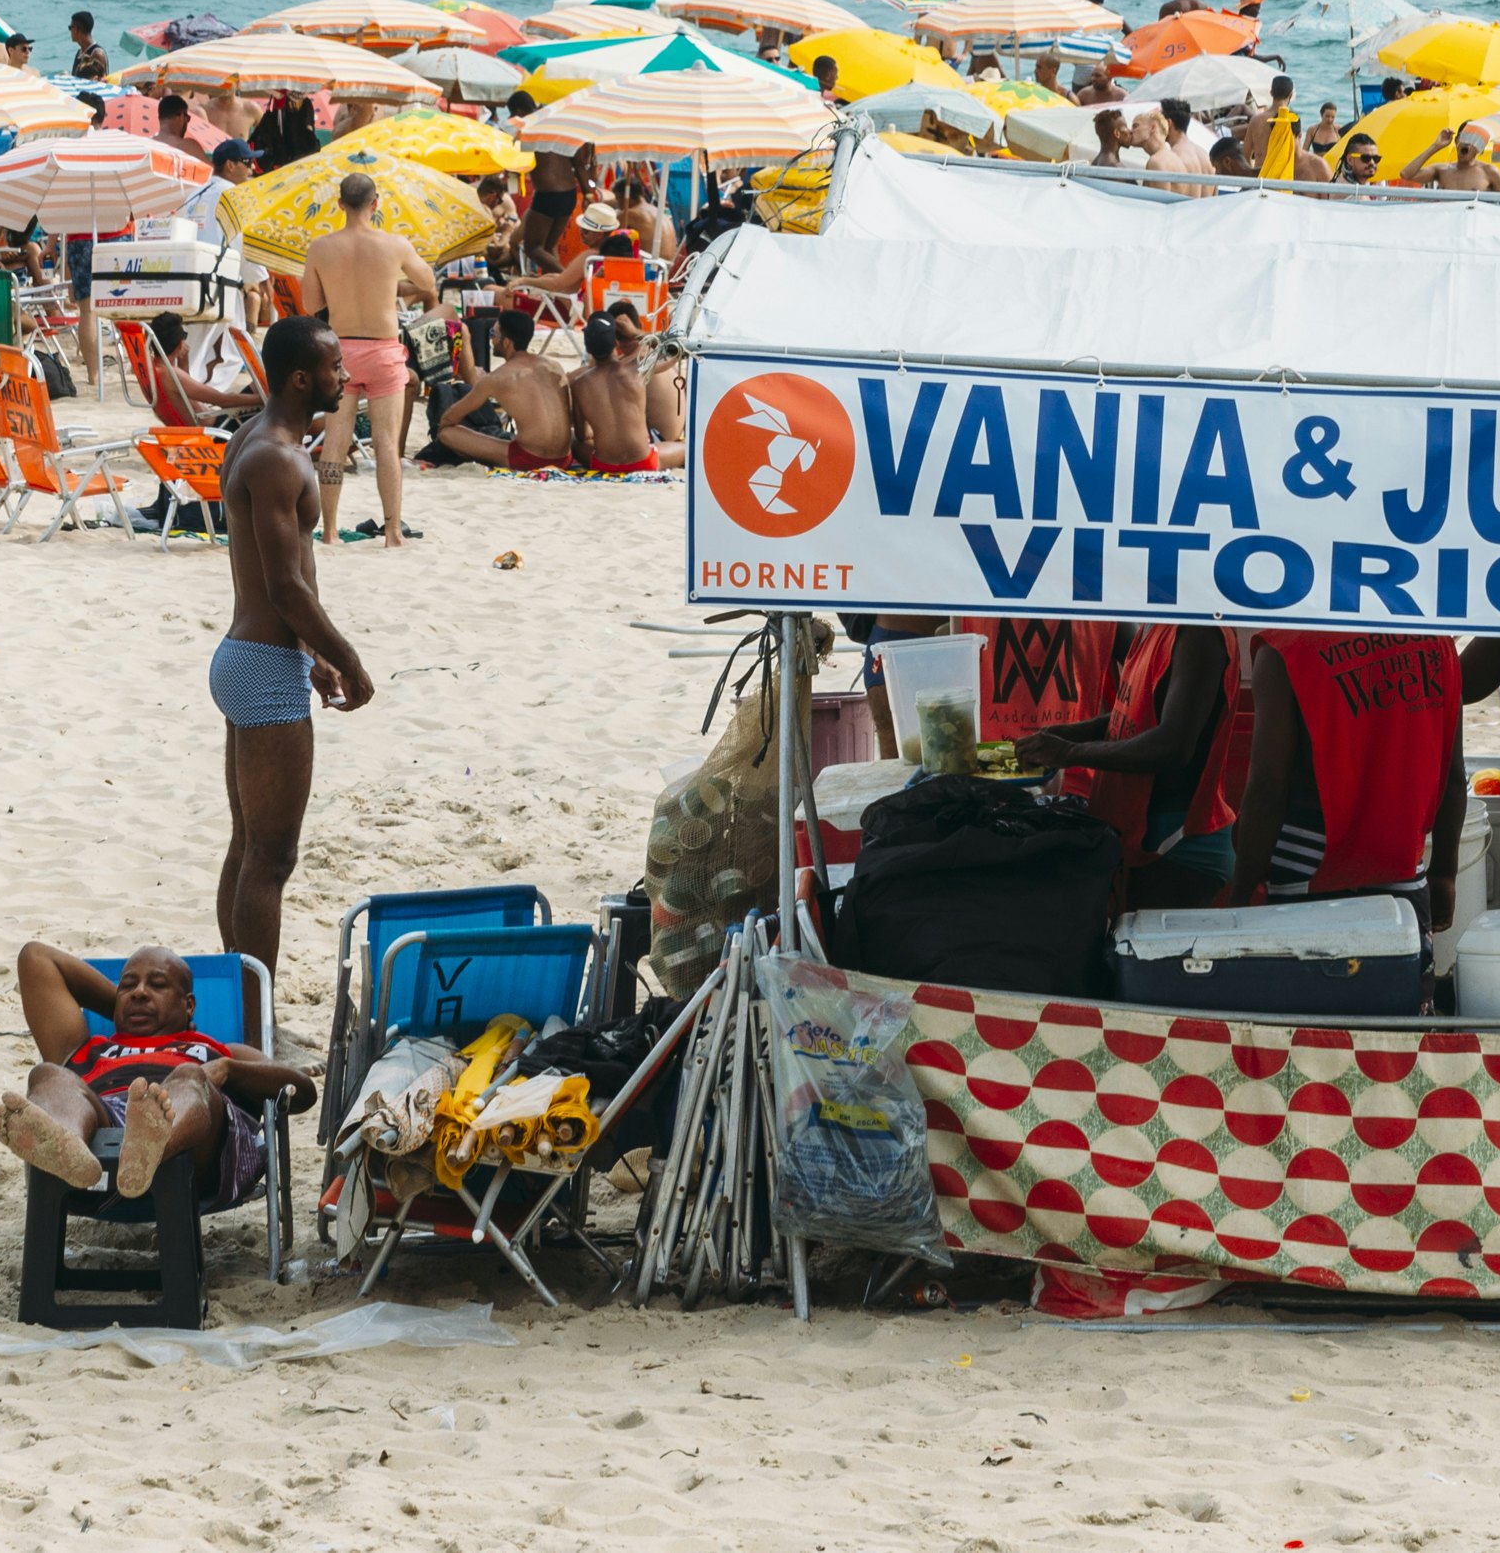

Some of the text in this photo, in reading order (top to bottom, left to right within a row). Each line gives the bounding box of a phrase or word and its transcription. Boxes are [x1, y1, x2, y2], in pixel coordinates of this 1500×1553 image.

[7, 410, 37, 440] 57X
[857, 377, 1260, 530] VANIA
[1282, 415, 1357, 501] &
[702, 561, 853, 591] HORNET
